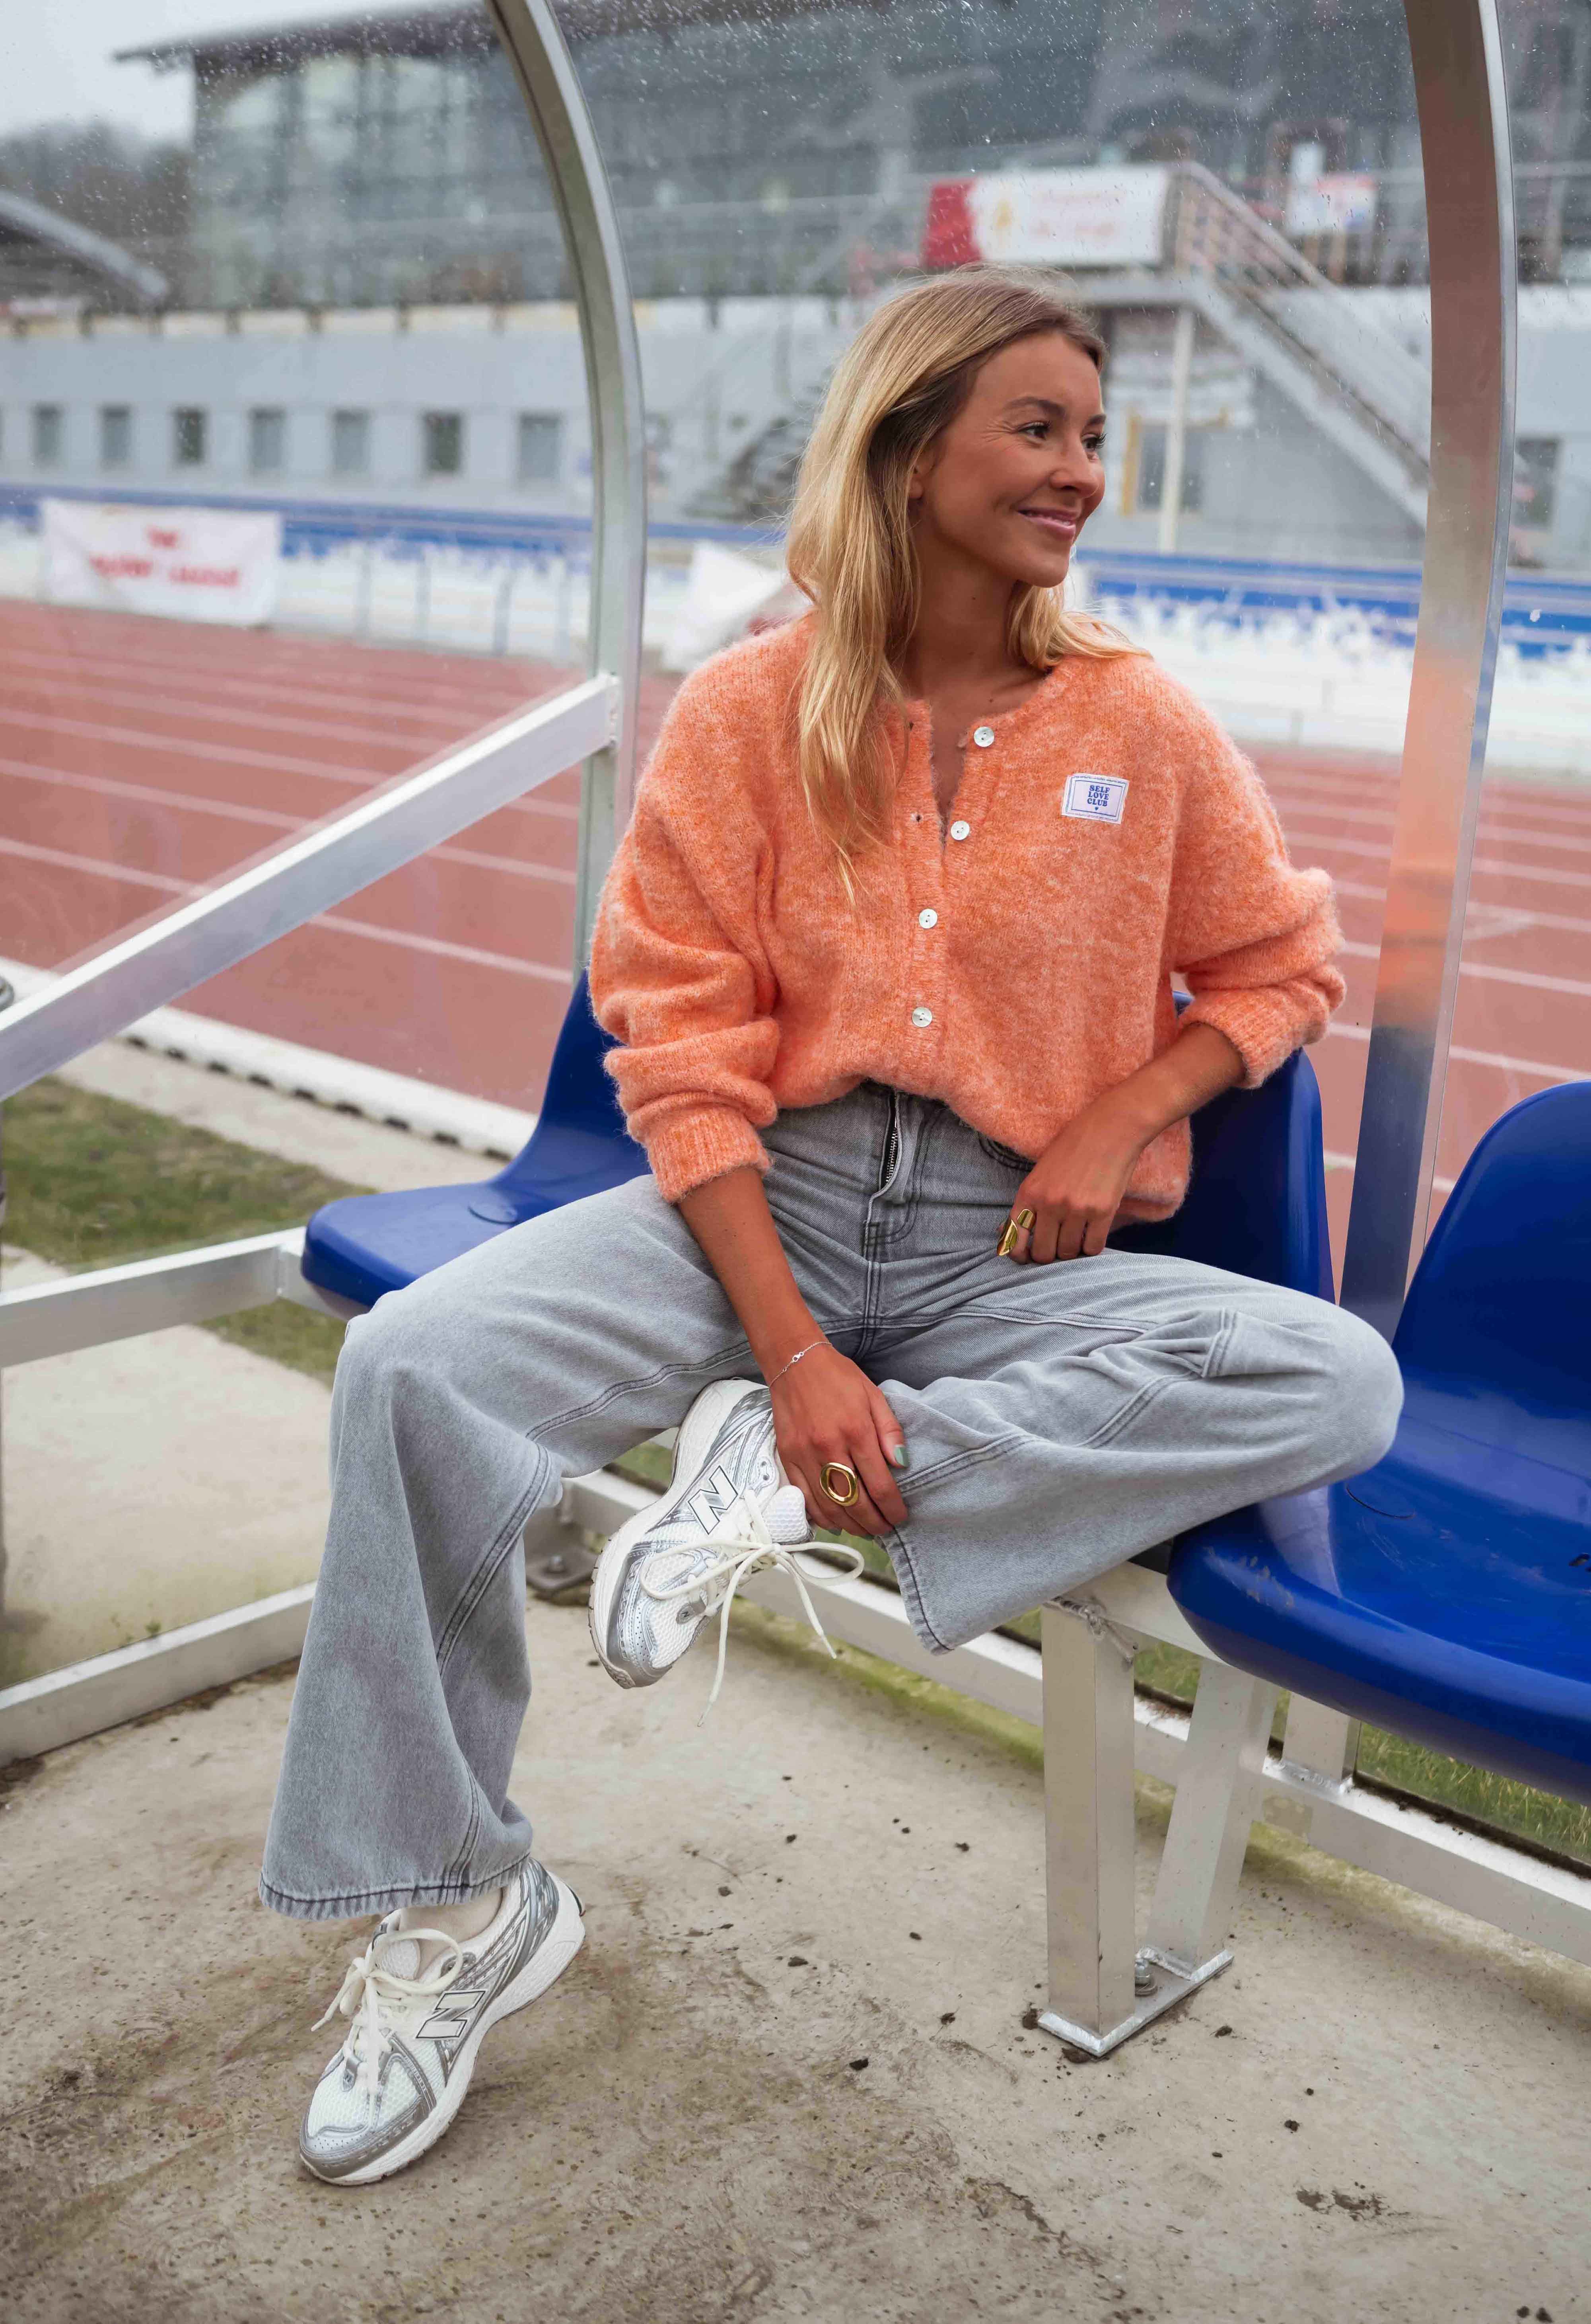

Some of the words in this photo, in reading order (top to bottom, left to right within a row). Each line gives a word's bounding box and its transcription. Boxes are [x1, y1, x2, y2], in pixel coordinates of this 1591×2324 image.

[1087, 798, 1108, 807] CLUB
[1088, 791, 1109, 800] LOVE
[688, 1465, 738, 1535] N
[416, 1990, 486, 2038] N
